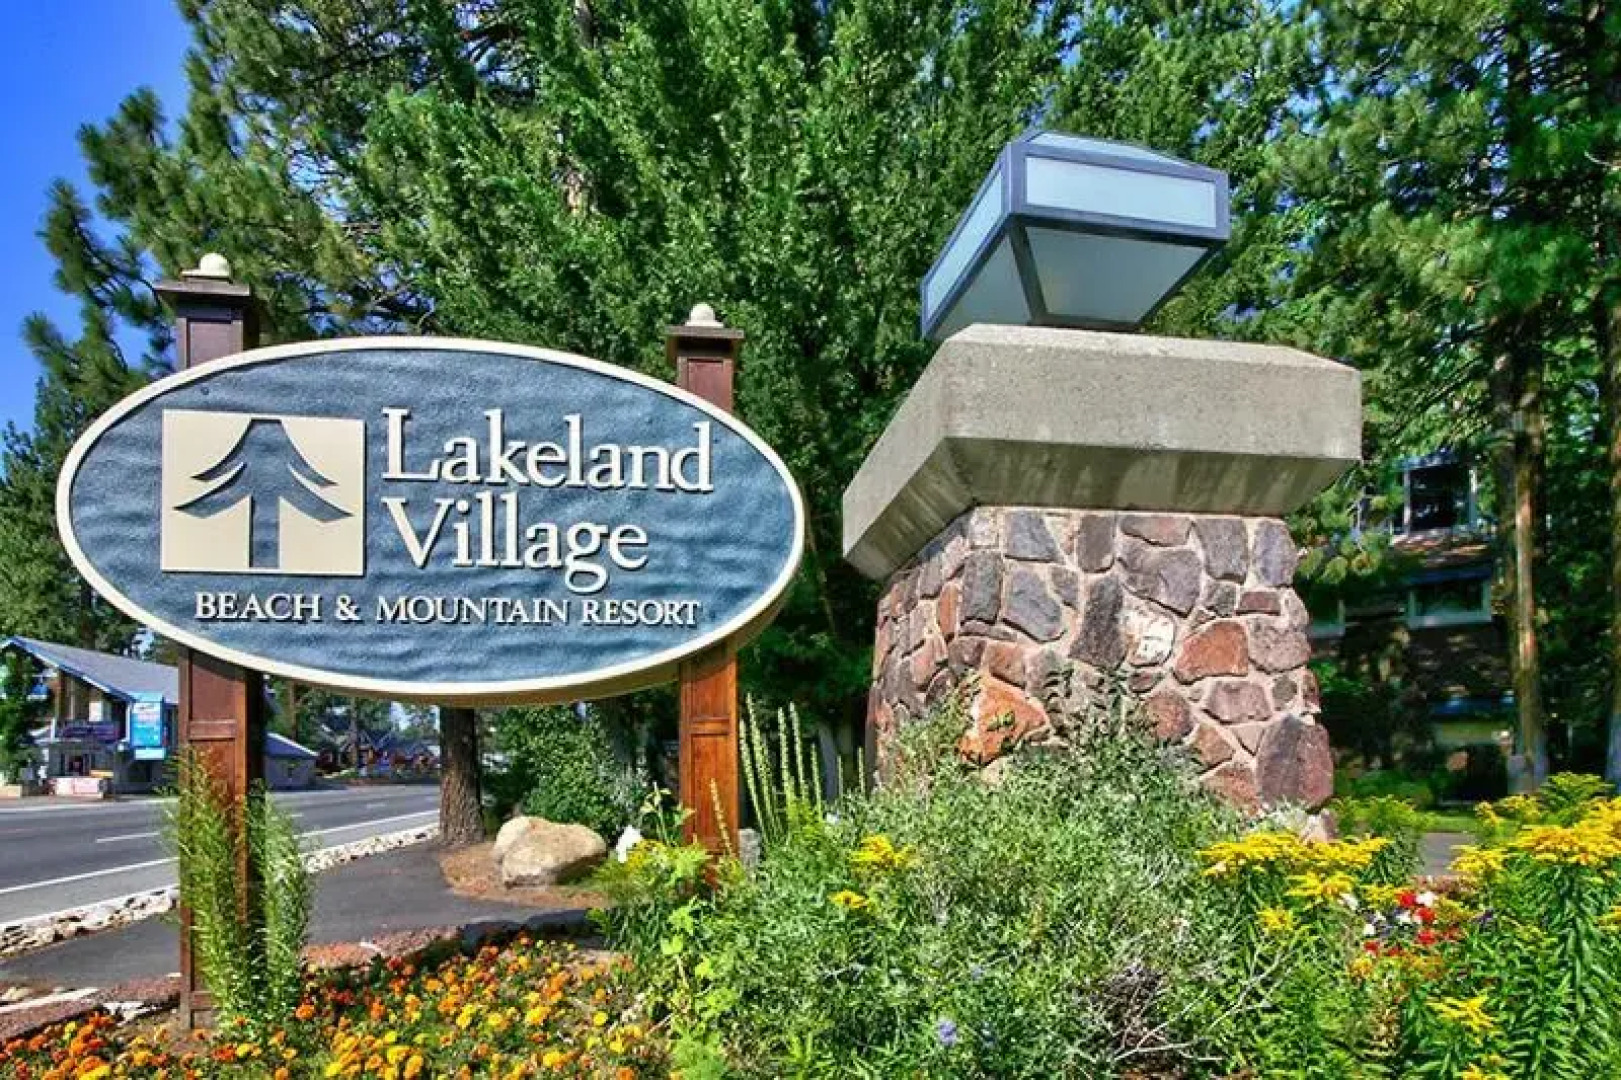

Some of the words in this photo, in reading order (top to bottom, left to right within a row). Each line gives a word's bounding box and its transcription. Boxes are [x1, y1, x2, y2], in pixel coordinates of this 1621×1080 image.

[382, 407, 714, 492] Lakeland
[381, 491, 649, 593] Village
[194, 592, 322, 622] BEACH
[334, 594, 361, 622] &
[376, 595, 568, 625] MOUNTAIN
[581, 599, 700, 627] RESORT
